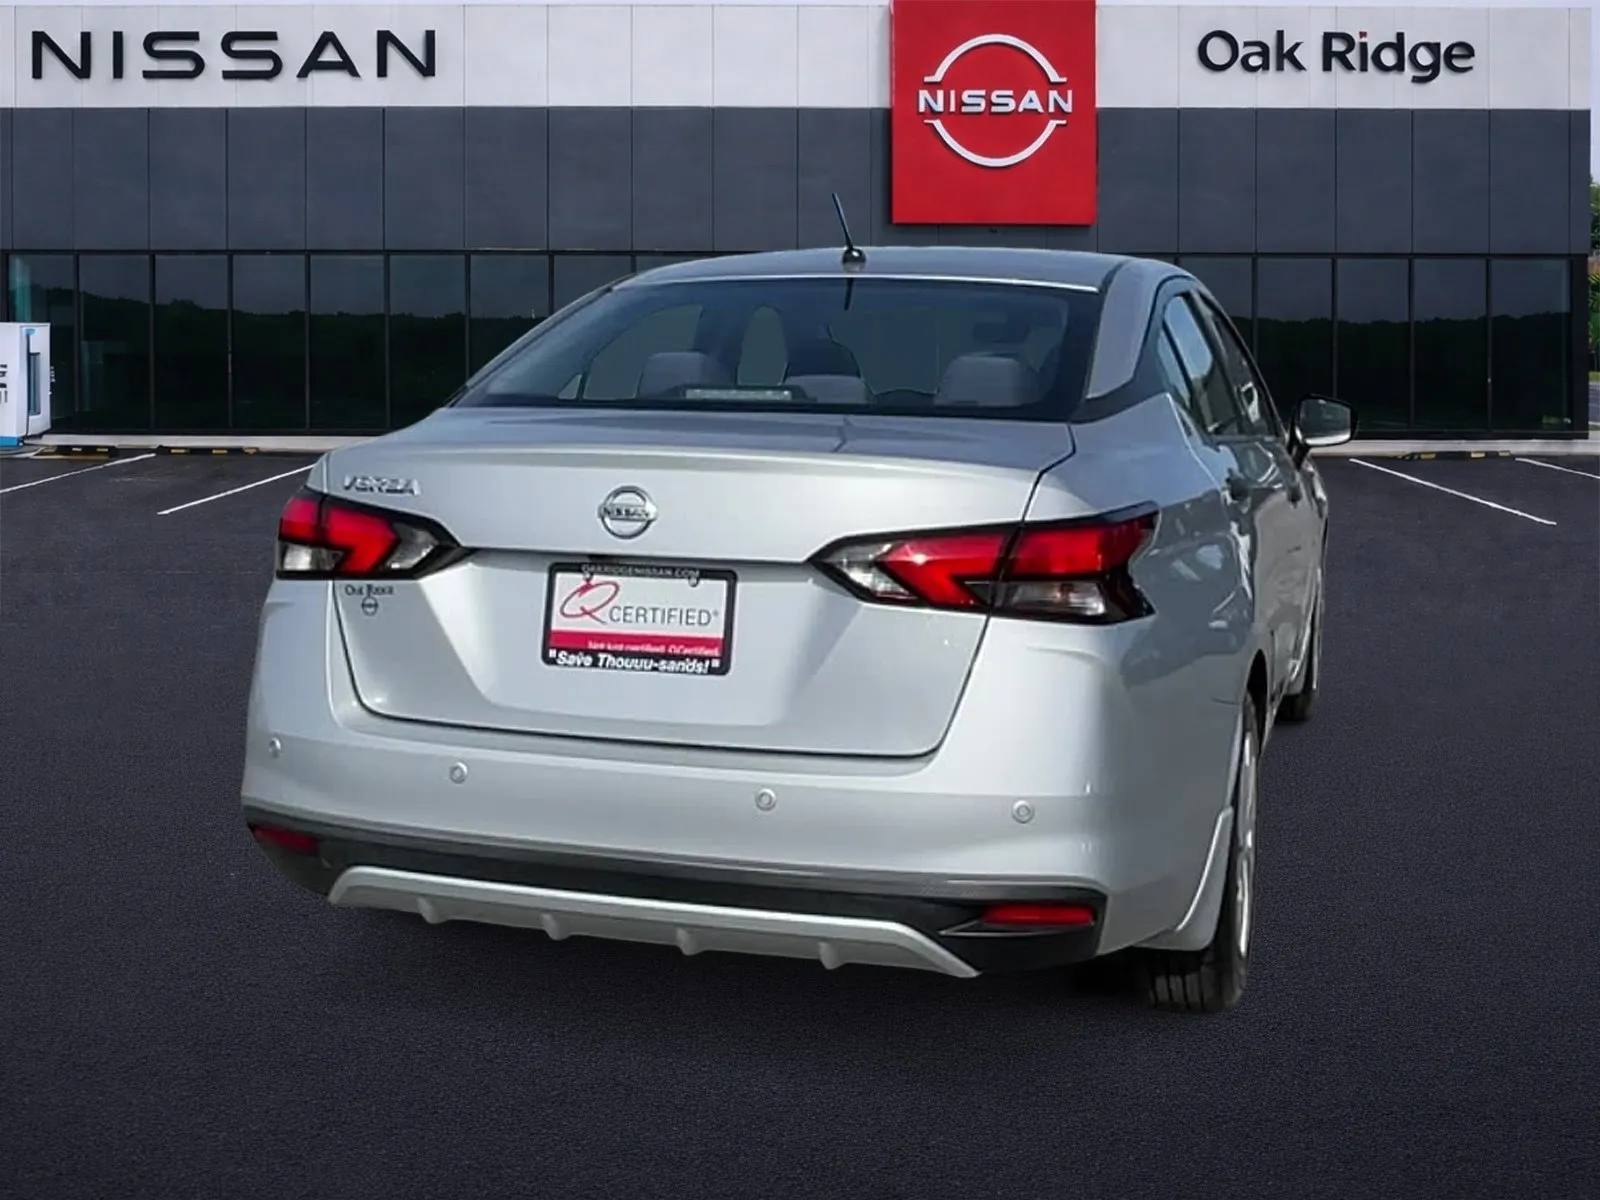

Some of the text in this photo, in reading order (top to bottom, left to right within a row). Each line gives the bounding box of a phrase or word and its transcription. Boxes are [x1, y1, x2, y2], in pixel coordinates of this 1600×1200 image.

[31, 29, 436, 82] NISSAN
[1197, 29, 1476, 85] Oak Ridge
[918, 89, 1073, 114] NISSAN
